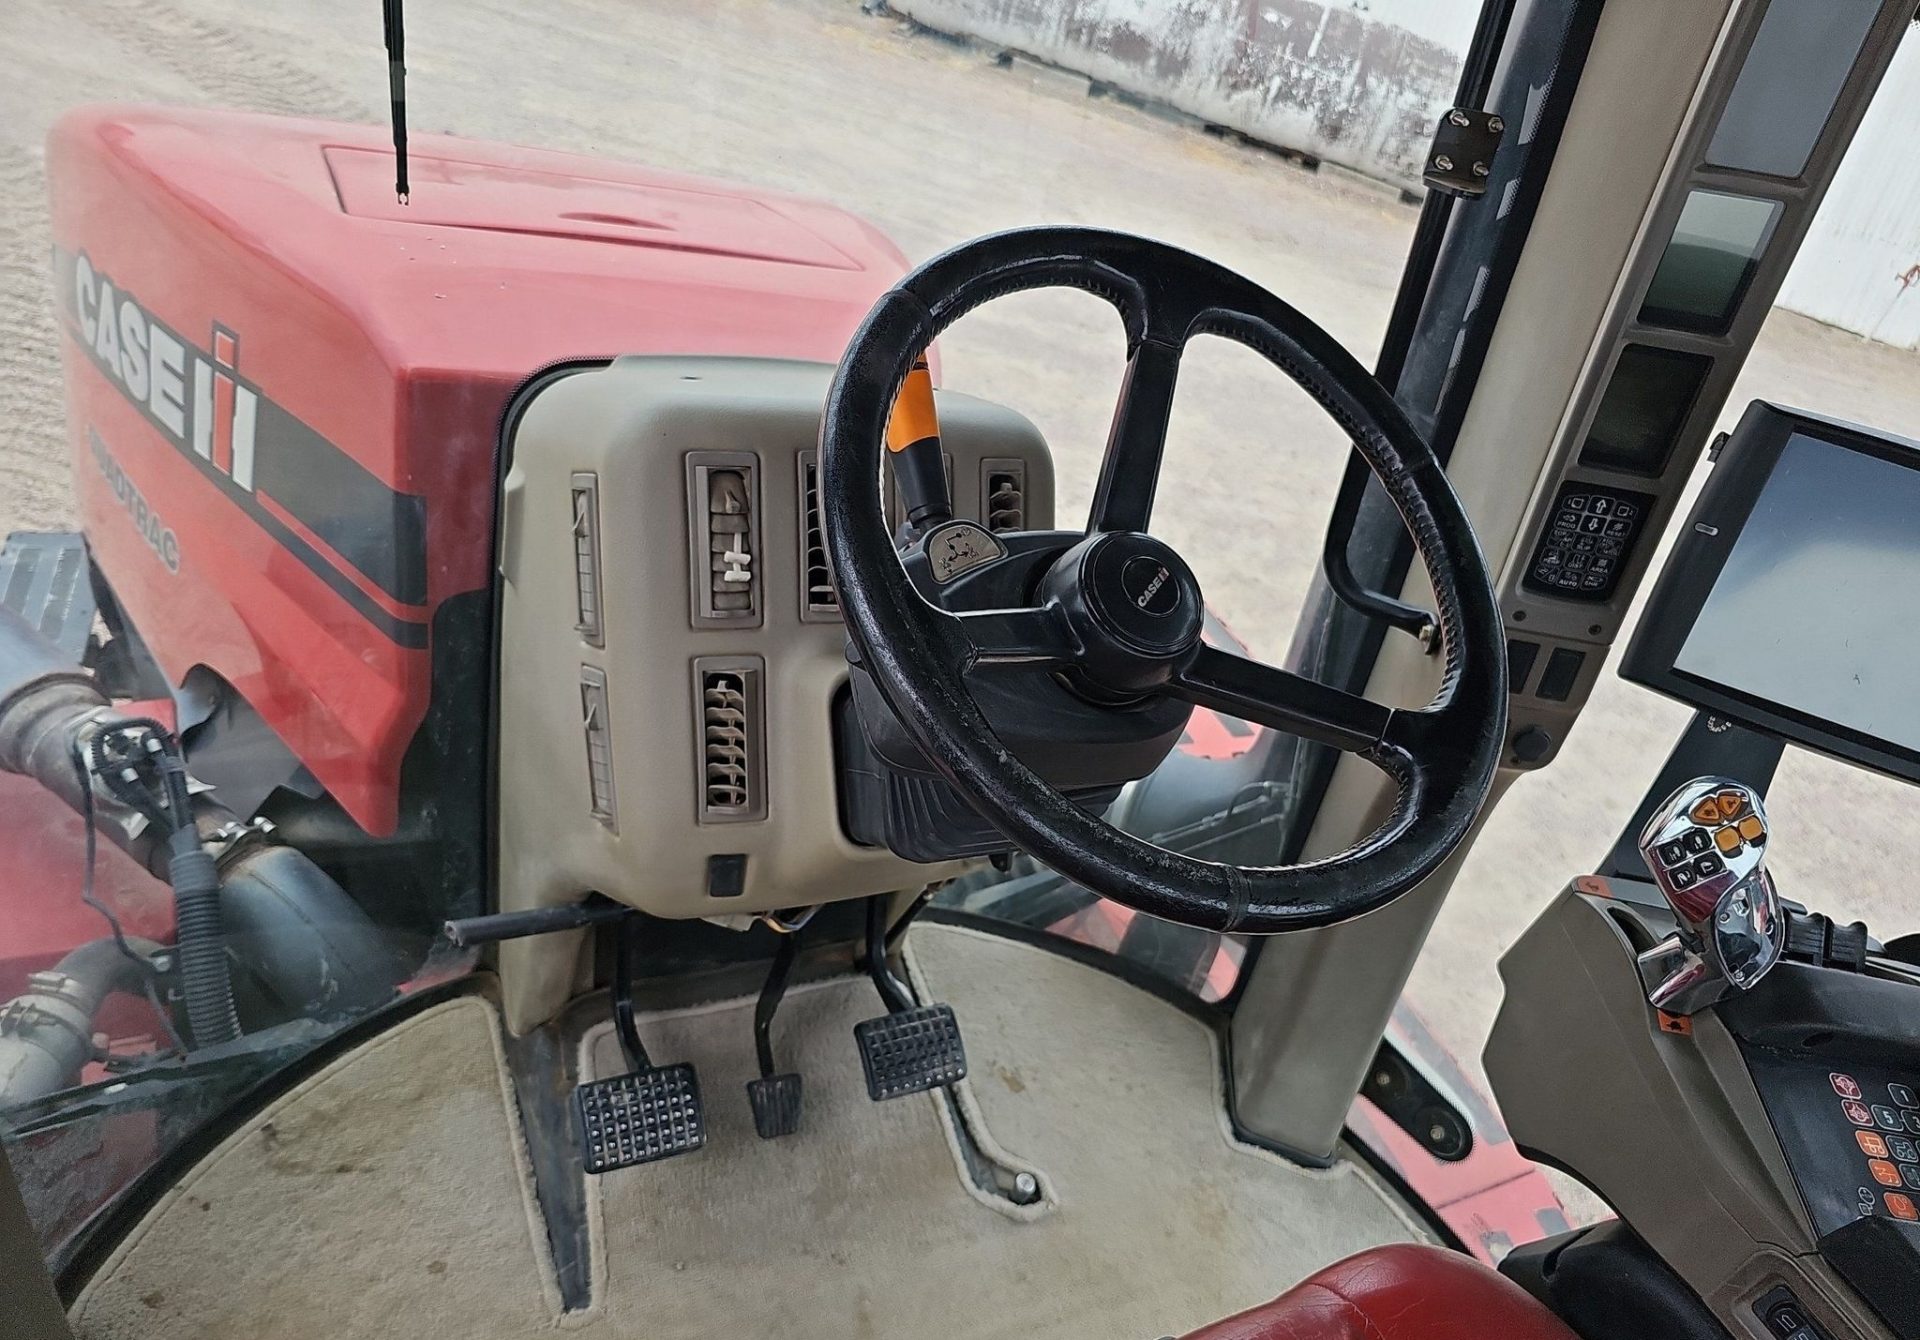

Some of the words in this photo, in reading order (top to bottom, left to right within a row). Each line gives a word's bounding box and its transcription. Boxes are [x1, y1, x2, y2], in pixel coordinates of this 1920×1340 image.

[76, 255, 185, 439] CASE
[1138, 576, 1163, 607] CASE
[1558, 579, 1578, 587] AUTO
[1882, 1110, 1894, 1125] 5
